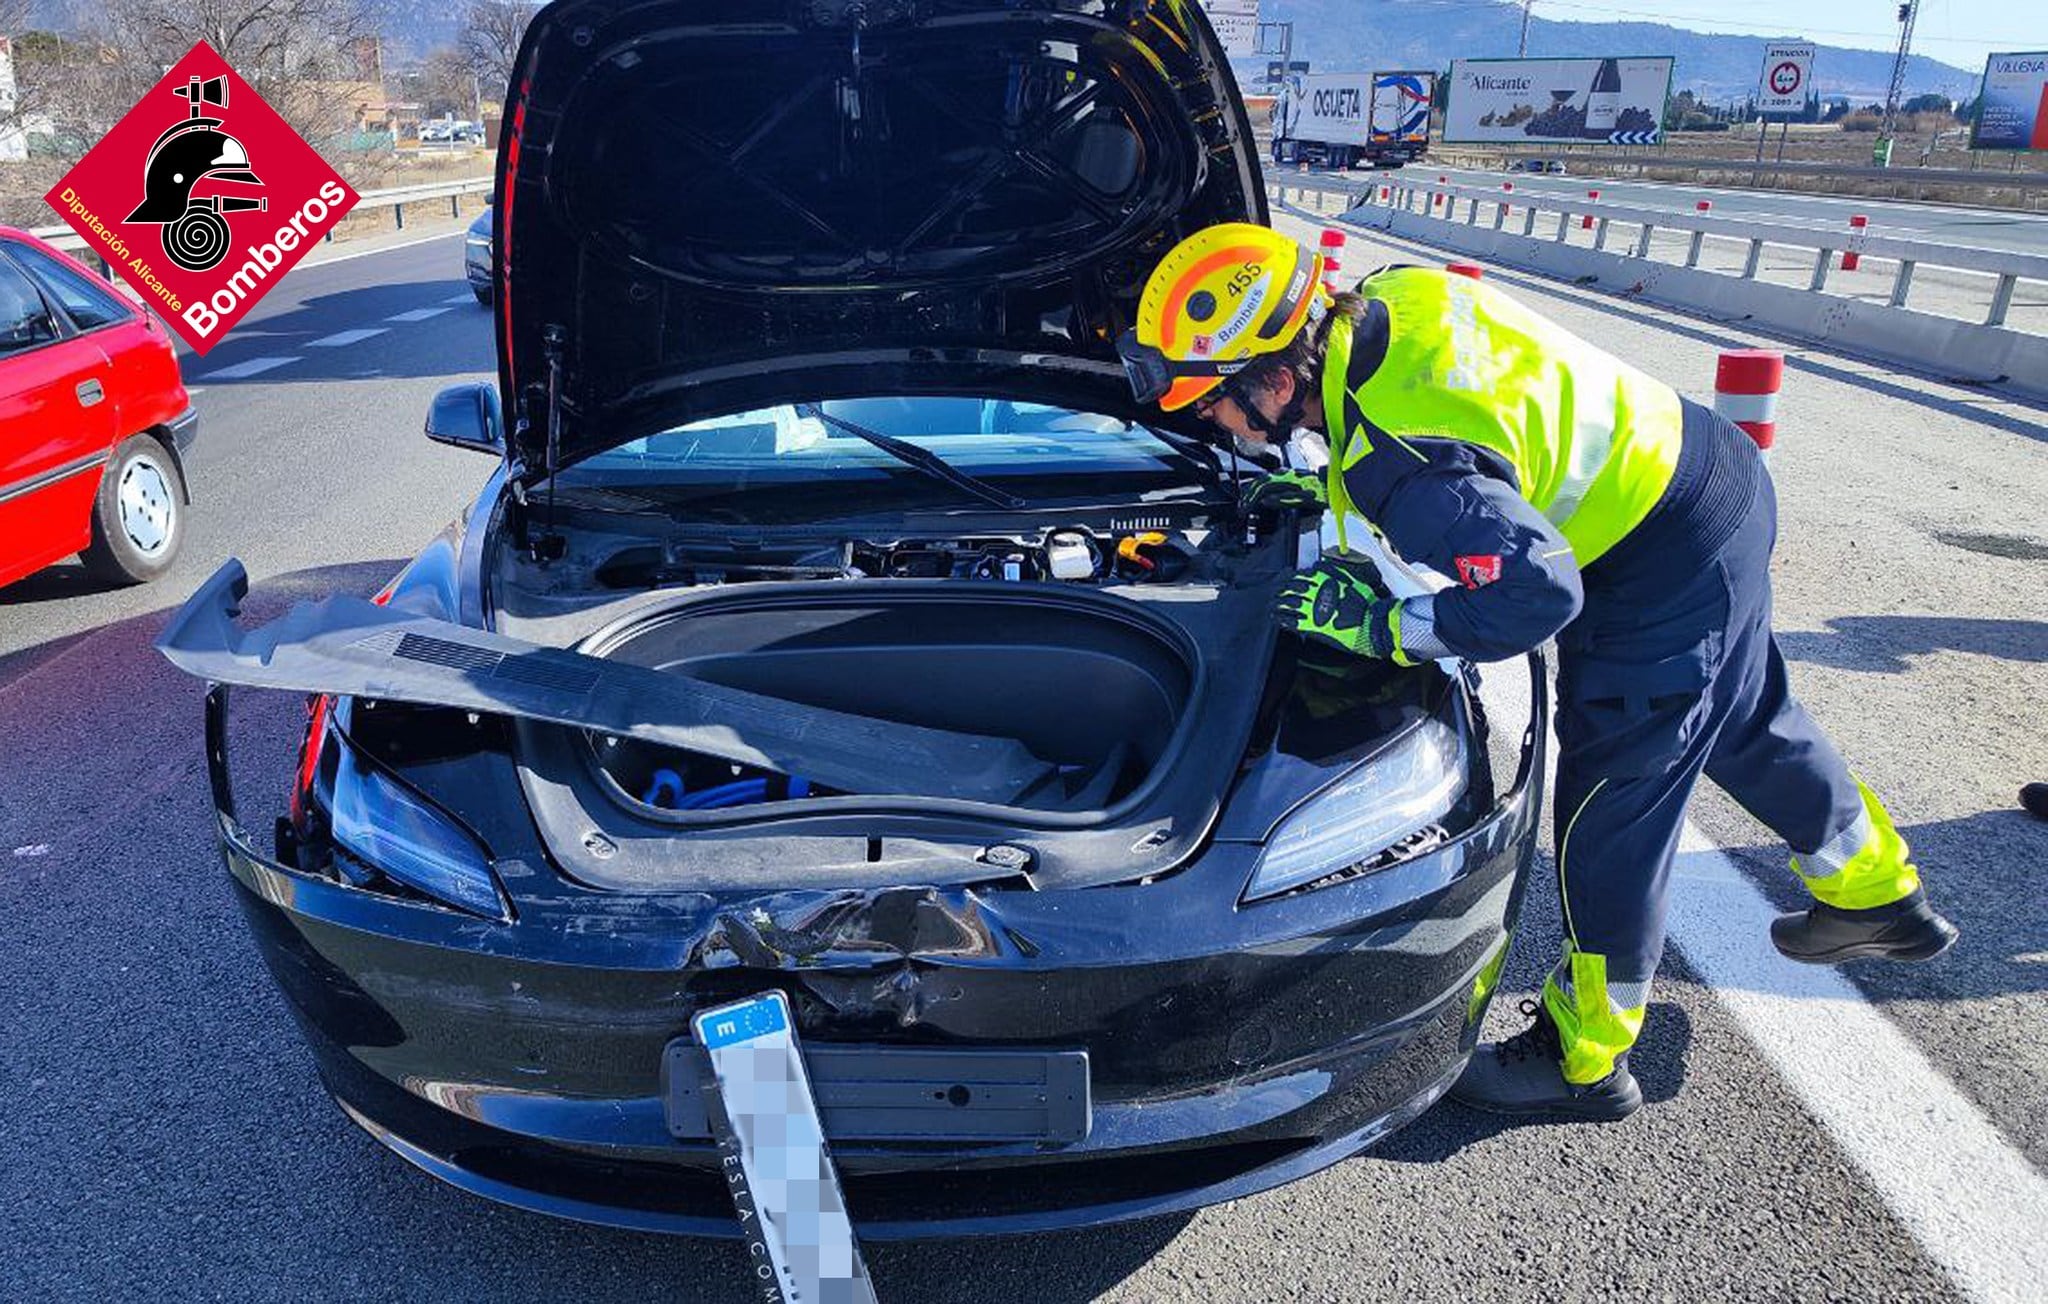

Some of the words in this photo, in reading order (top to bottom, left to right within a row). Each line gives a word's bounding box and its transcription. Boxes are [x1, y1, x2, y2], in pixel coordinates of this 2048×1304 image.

[1470, 75, 1532, 90] Alicante
[1313, 88, 1361, 118] OGUETA
[1226, 261, 1262, 298] 455
[1218, 288, 1264, 342] Bombers
[716, 1021, 736, 1038] E
